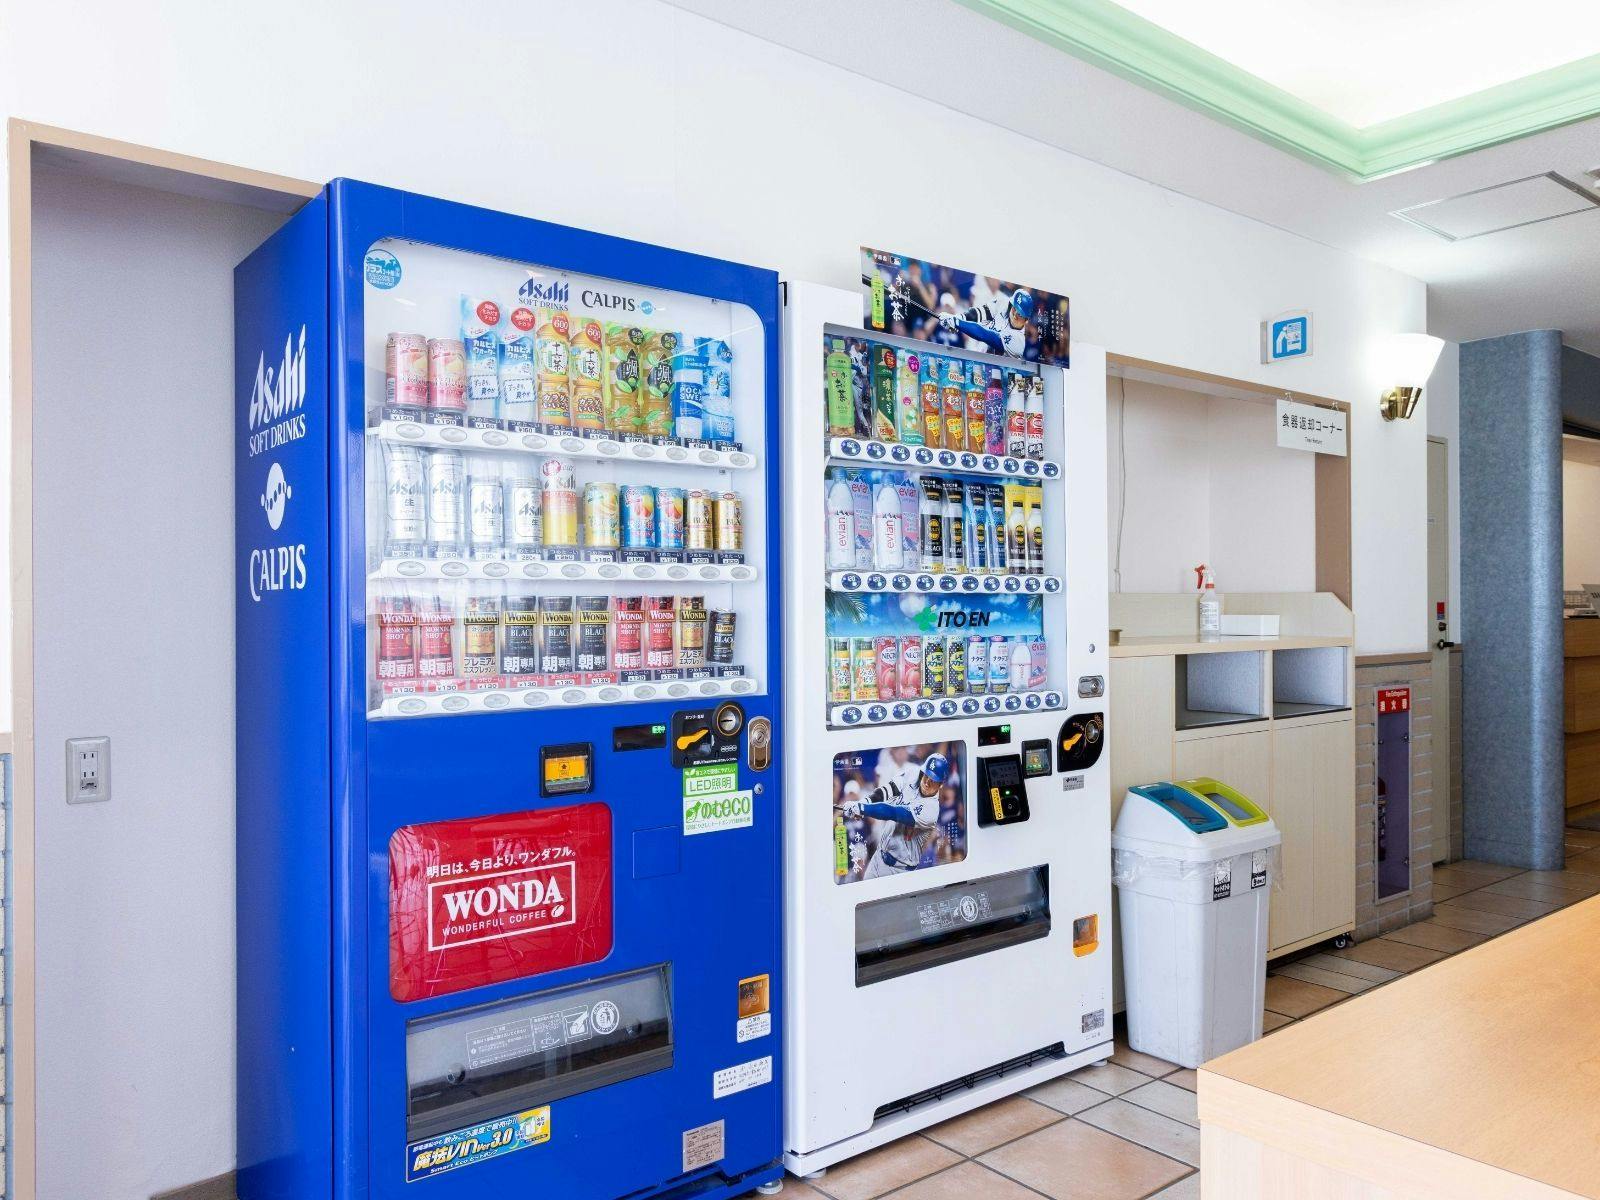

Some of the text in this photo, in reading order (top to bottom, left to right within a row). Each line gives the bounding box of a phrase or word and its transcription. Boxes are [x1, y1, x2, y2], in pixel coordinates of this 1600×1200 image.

[519, 277, 569, 303] Asahi
[518, 297, 569, 312] SOFT DRINKS
[582, 290, 636, 312] CALPIS
[249, 323, 306, 431] Asahi
[1282, 413, 1343, 434] 食器返却コーナー
[249, 414, 306, 457] SOFT DRINKS
[839, 515, 848, 547] evian
[886, 518, 895, 549] evian
[249, 543, 306, 602] CALPIS
[382, 612, 415, 624] WONDA
[420, 611, 453, 624] WONDA
[467, 612, 497, 623] WONDA
[508, 611, 536, 622] WONDA
[545, 611, 572, 622] WONDA
[582, 611, 608, 621] WONDA
[617, 610, 643, 621] WONDA
[651, 610, 674, 621] WONDA
[682, 610, 706, 620] WONDA
[938, 611, 991, 629] ITO EN
[689, 776, 732, 792] LED照明
[427, 846, 577, 879] 明日は、今日より、ワンダフル。
[442, 876, 565, 922] WONDA
[442, 910, 546, 937] WONDERFUL COFFEE
[491, 1128, 514, 1150] 3.0
